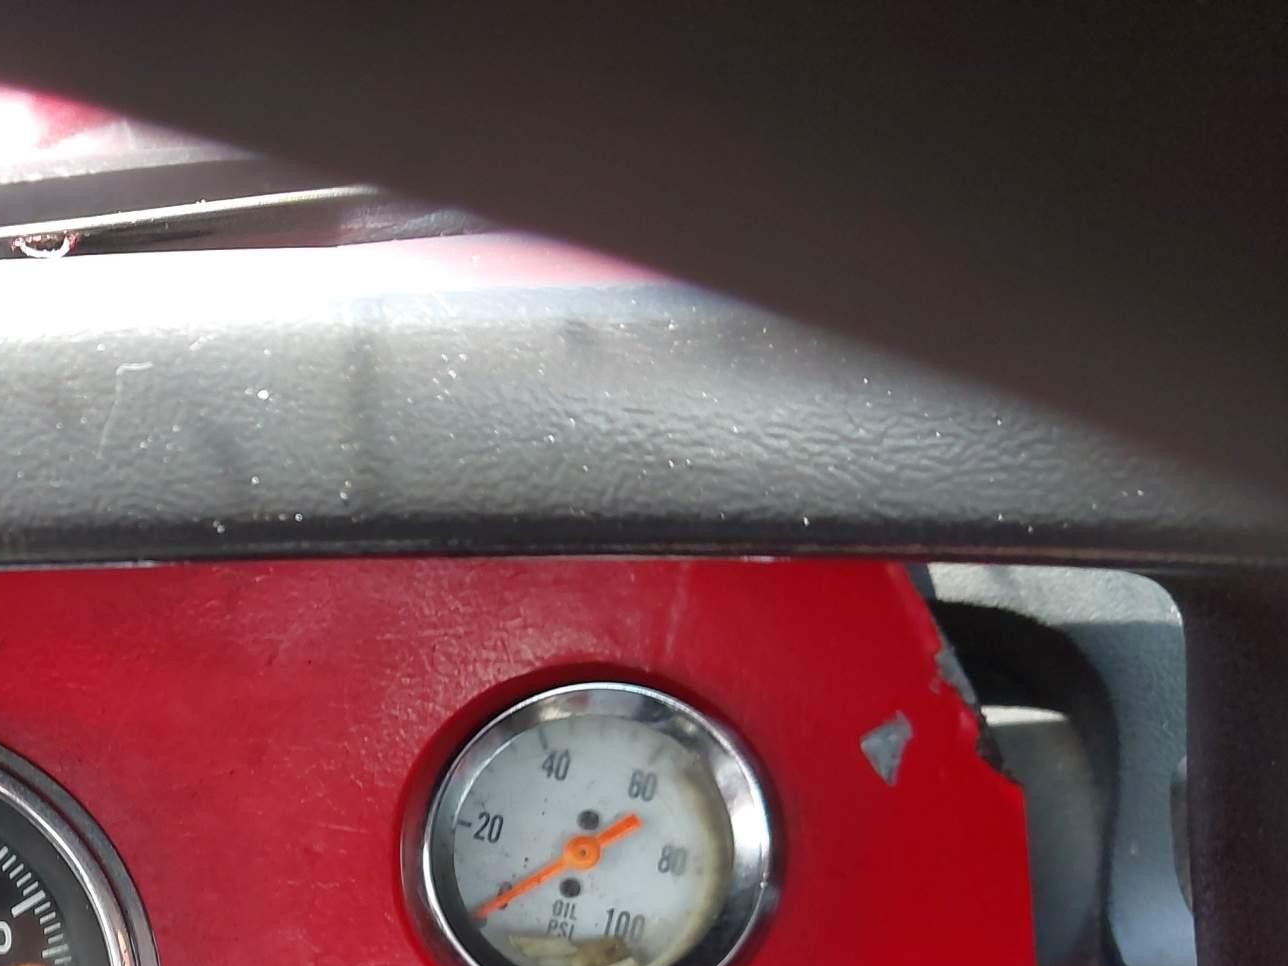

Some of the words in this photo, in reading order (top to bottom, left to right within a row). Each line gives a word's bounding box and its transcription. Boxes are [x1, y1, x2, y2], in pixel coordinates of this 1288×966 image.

[542, 750, 571, 781] 40
[628, 769, 657, 801] 60
[473, 812, 504, 843] 20
[657, 845, 688, 876] 80
[552, 900, 576, 921] OIL
[603, 908, 646, 944] 100
[546, 919, 575, 940] PSI
